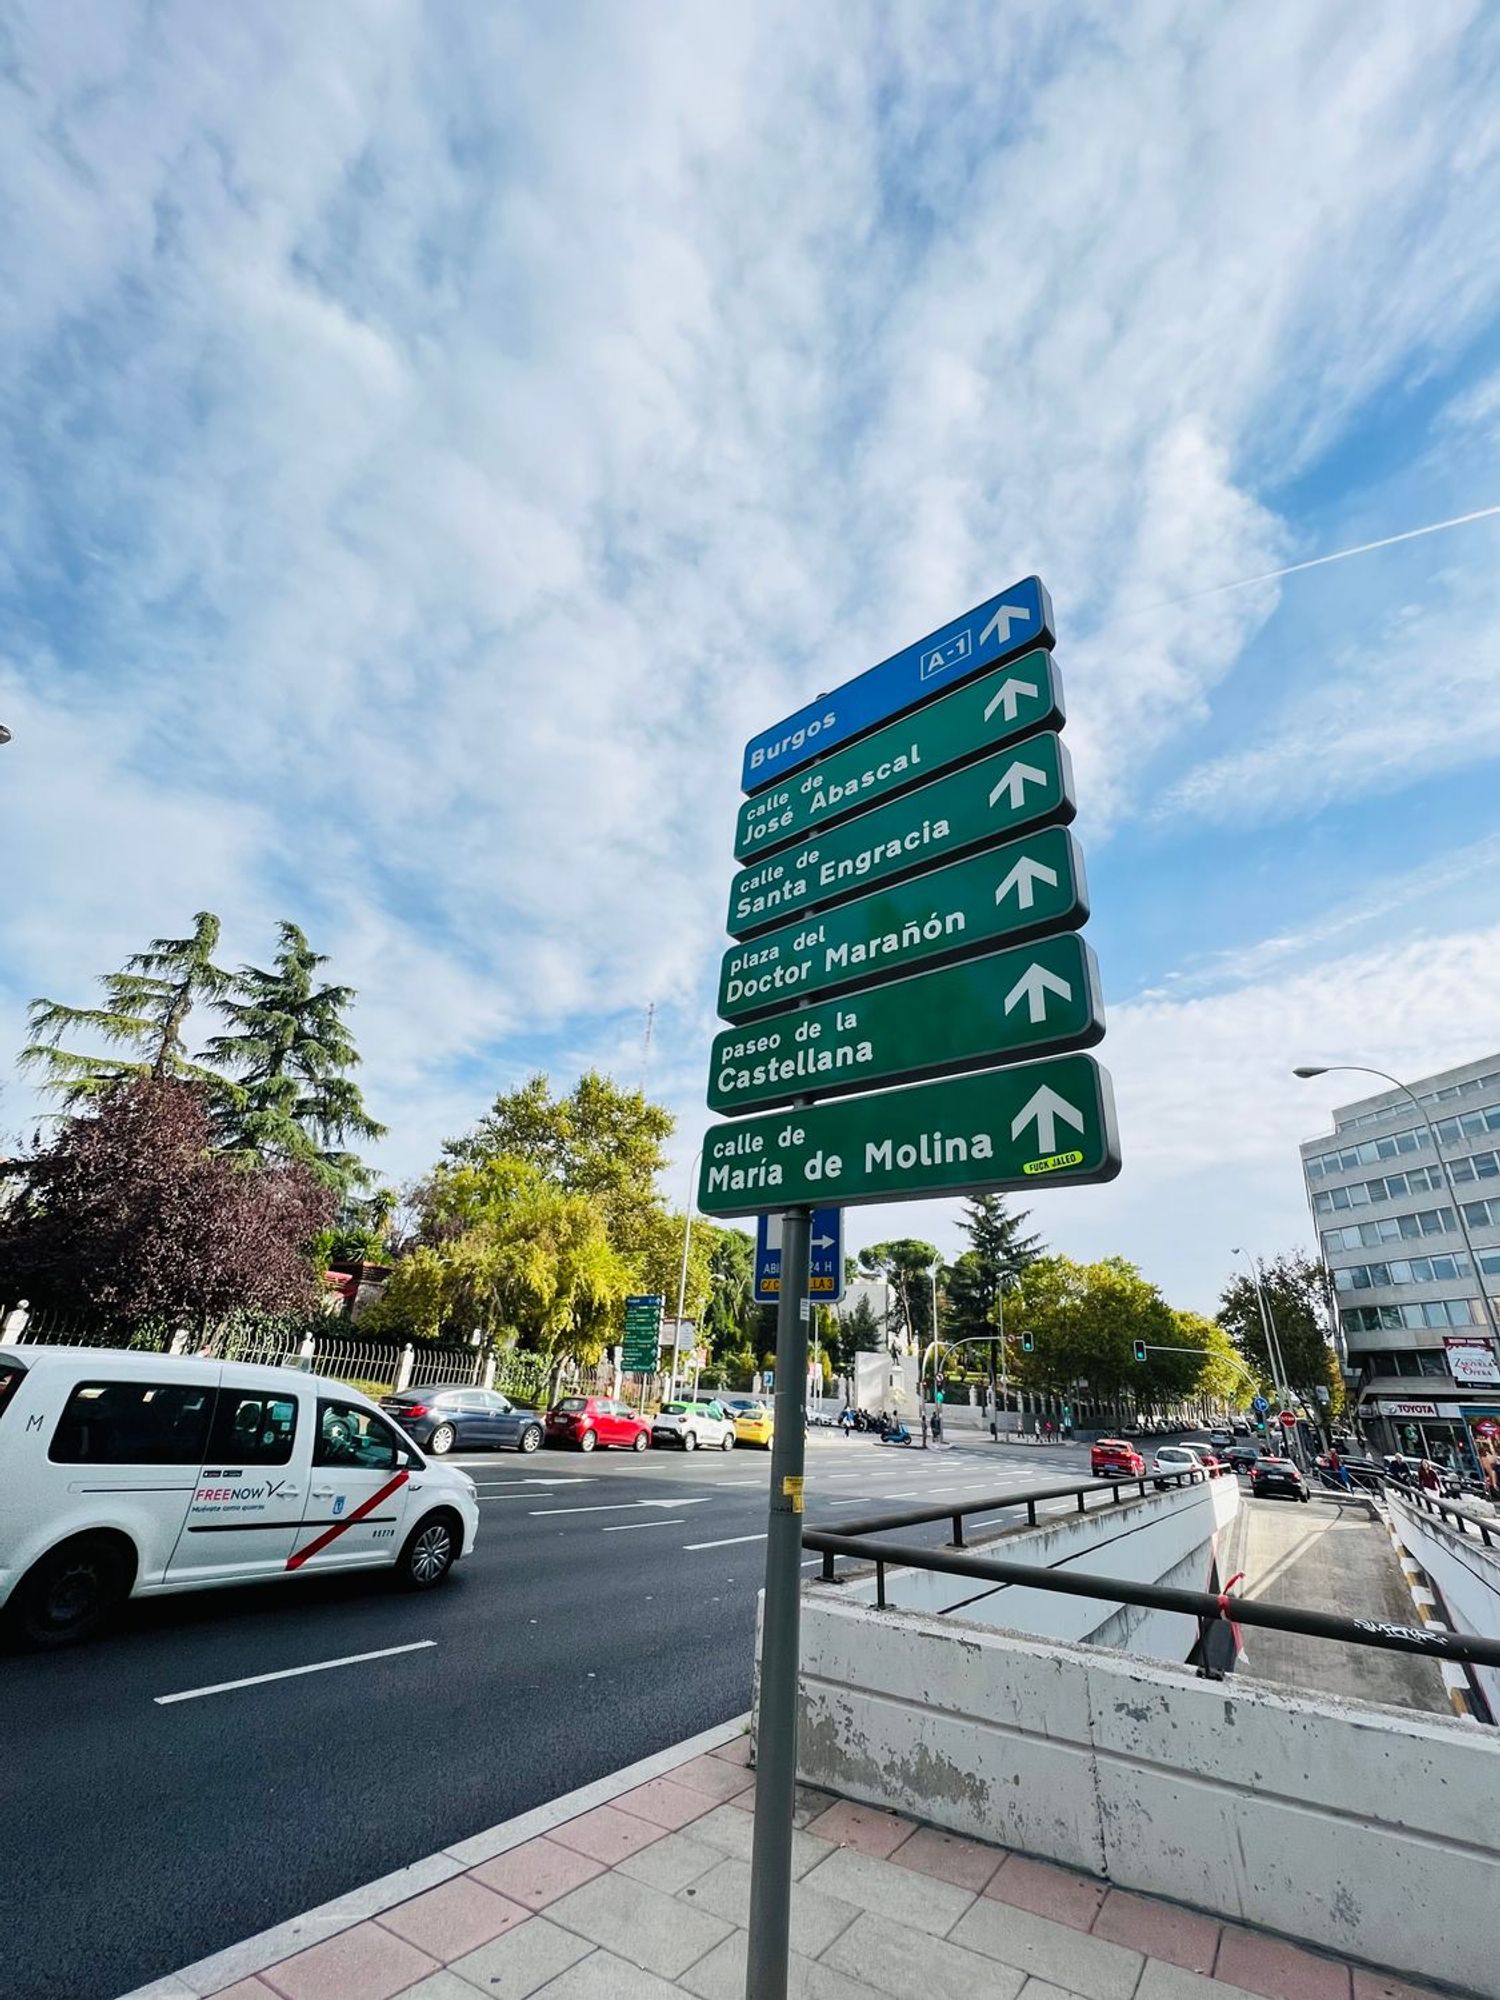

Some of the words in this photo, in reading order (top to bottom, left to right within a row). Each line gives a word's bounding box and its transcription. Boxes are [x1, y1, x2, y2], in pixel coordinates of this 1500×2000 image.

[750, 712, 836, 769] Burgos
[928, 637, 966, 672] A-1
[742, 805, 793, 845] José
[809, 744, 921, 813] Abascal
[747, 793, 789, 821] calle
[800, 774, 824, 794] de
[736, 879, 807, 919] Santa
[820, 820, 950, 886] Engracia
[740, 866, 784, 893] calle
[796, 849, 820, 869] de
[726, 960, 812, 1003] Doctor
[825, 910, 966, 972] Marañón
[730, 946, 779, 977] plaza
[793, 925, 826, 951] del
[721, 1033, 781, 1065] paseo
[794, 1021, 822, 1042] de
[836, 1011, 857, 1032] la
[717, 1041, 873, 1092] Castellana
[707, 1157, 783, 1193] María
[804, 1150, 843, 1181] de
[865, 1131, 993, 1173] Molina
[713, 1132, 764, 1159] calle
[778, 1125, 805, 1148] de
[1029, 1160, 1050, 1171] FUCK
[824, 1261, 832, 1272] H
[26, 1415, 44, 1432] M
[1397, 1404, 1435, 1414] TOYOTA
[196, 1487, 264, 1501] FREENOW
